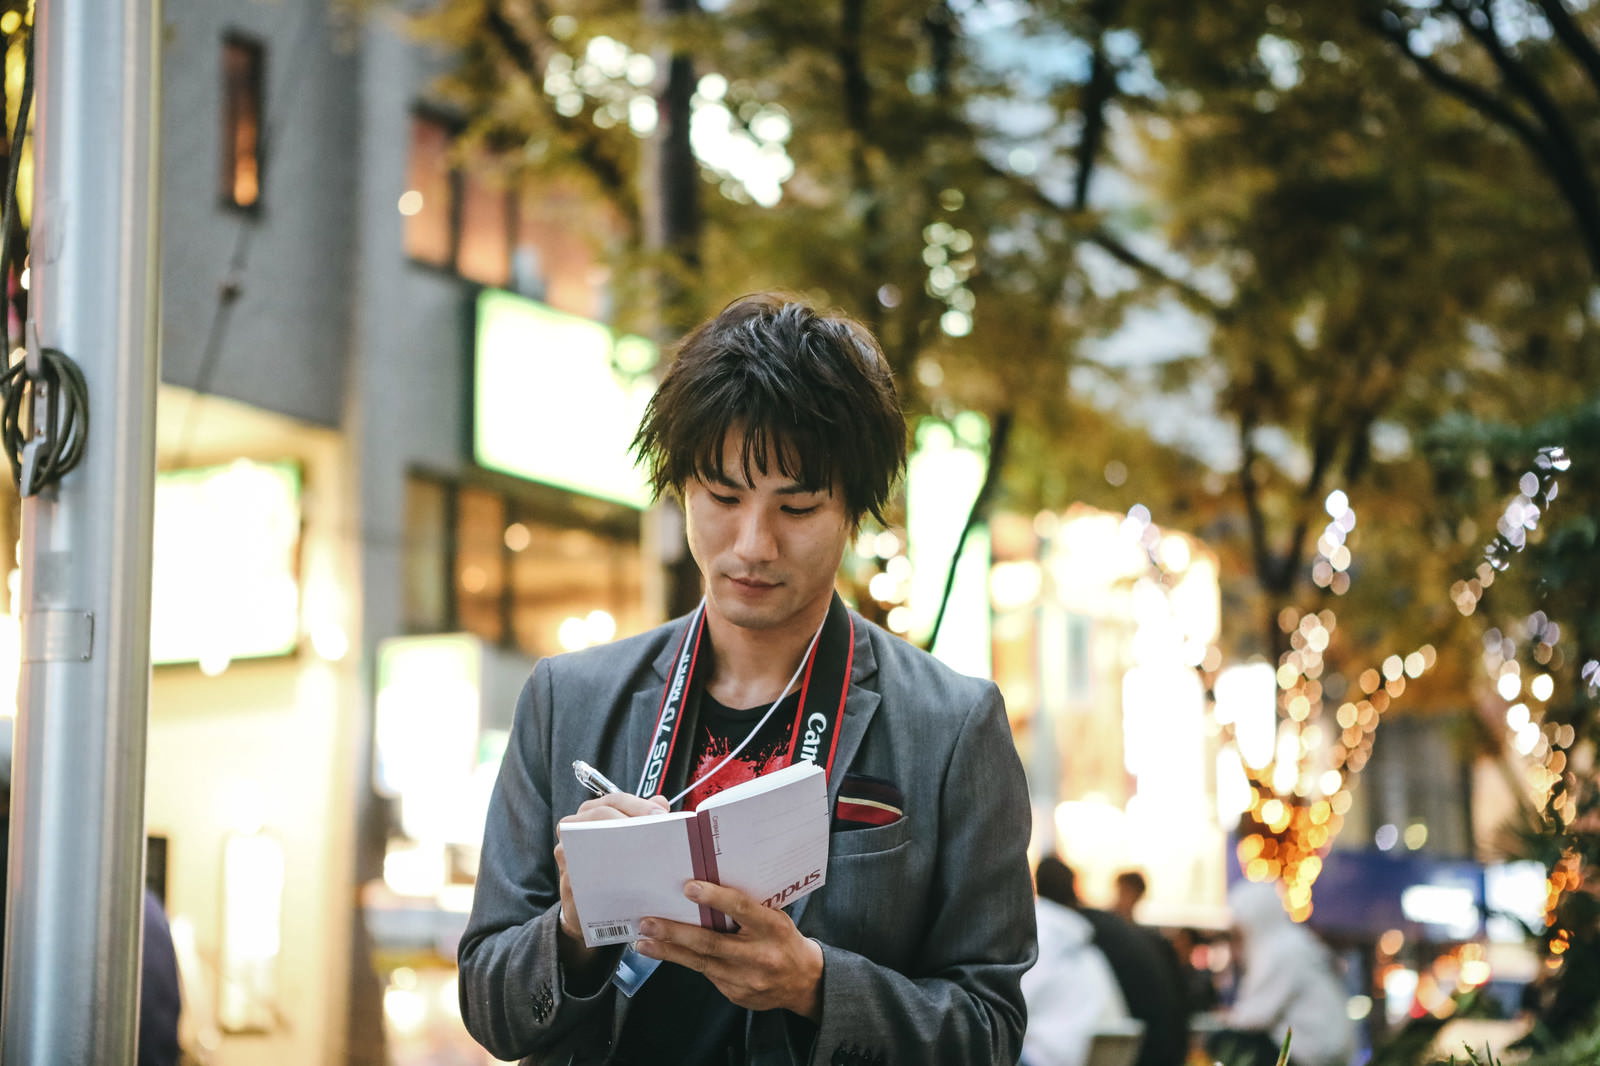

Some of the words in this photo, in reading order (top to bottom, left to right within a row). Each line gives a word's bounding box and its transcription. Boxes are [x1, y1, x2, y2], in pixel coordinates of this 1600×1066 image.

[642, 741, 667, 798] EOS
[658, 707, 676, 737] 7D
[671, 664, 688, 702] Mark
[800, 712, 827, 761] Can
[760, 868, 821, 908] mpus
